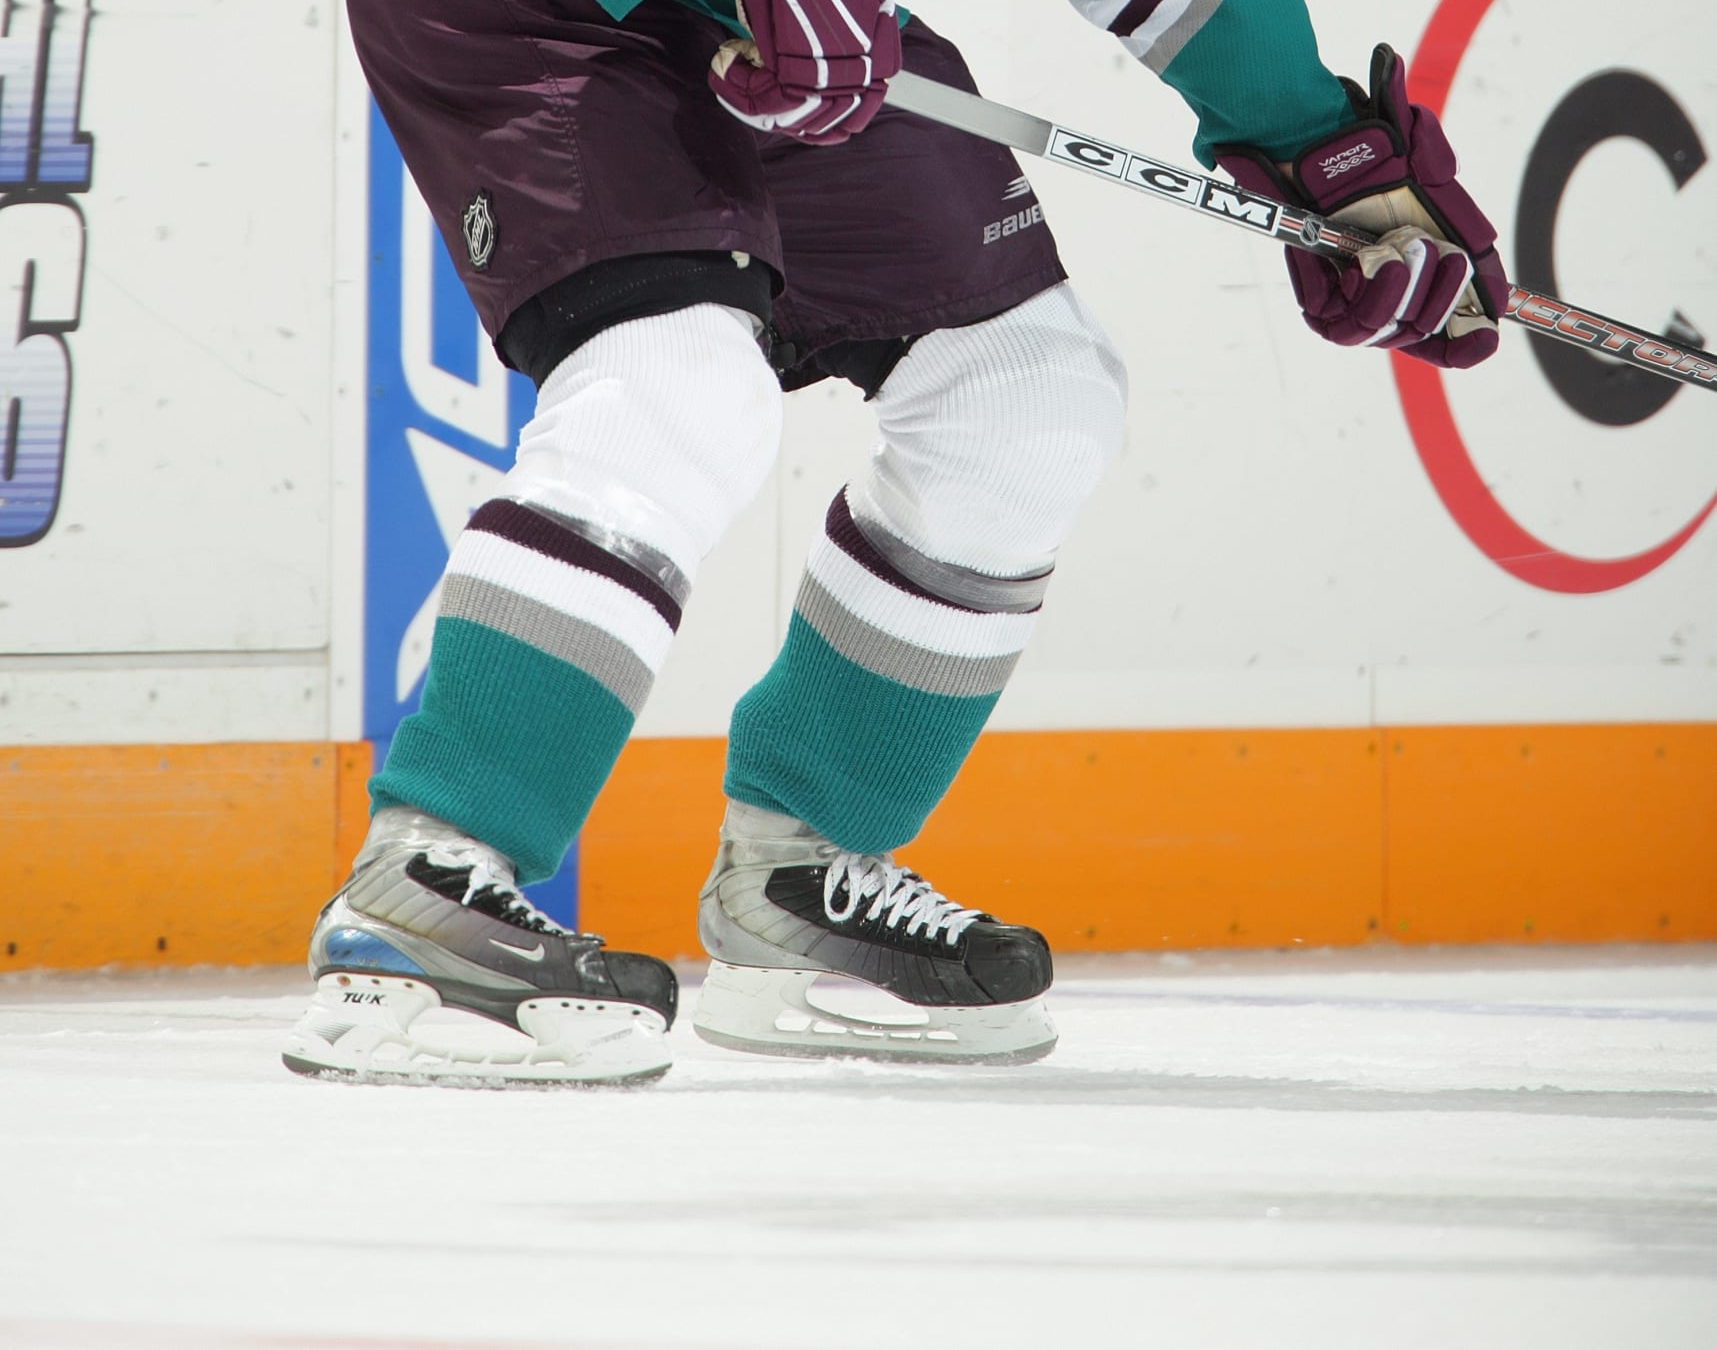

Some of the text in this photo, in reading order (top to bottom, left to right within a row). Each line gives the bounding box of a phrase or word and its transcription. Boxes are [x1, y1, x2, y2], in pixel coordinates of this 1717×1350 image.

[1318, 143, 1371, 167] VAPOR
[1050, 129, 1283, 236] CCM
[983, 203, 1046, 245] Baue
